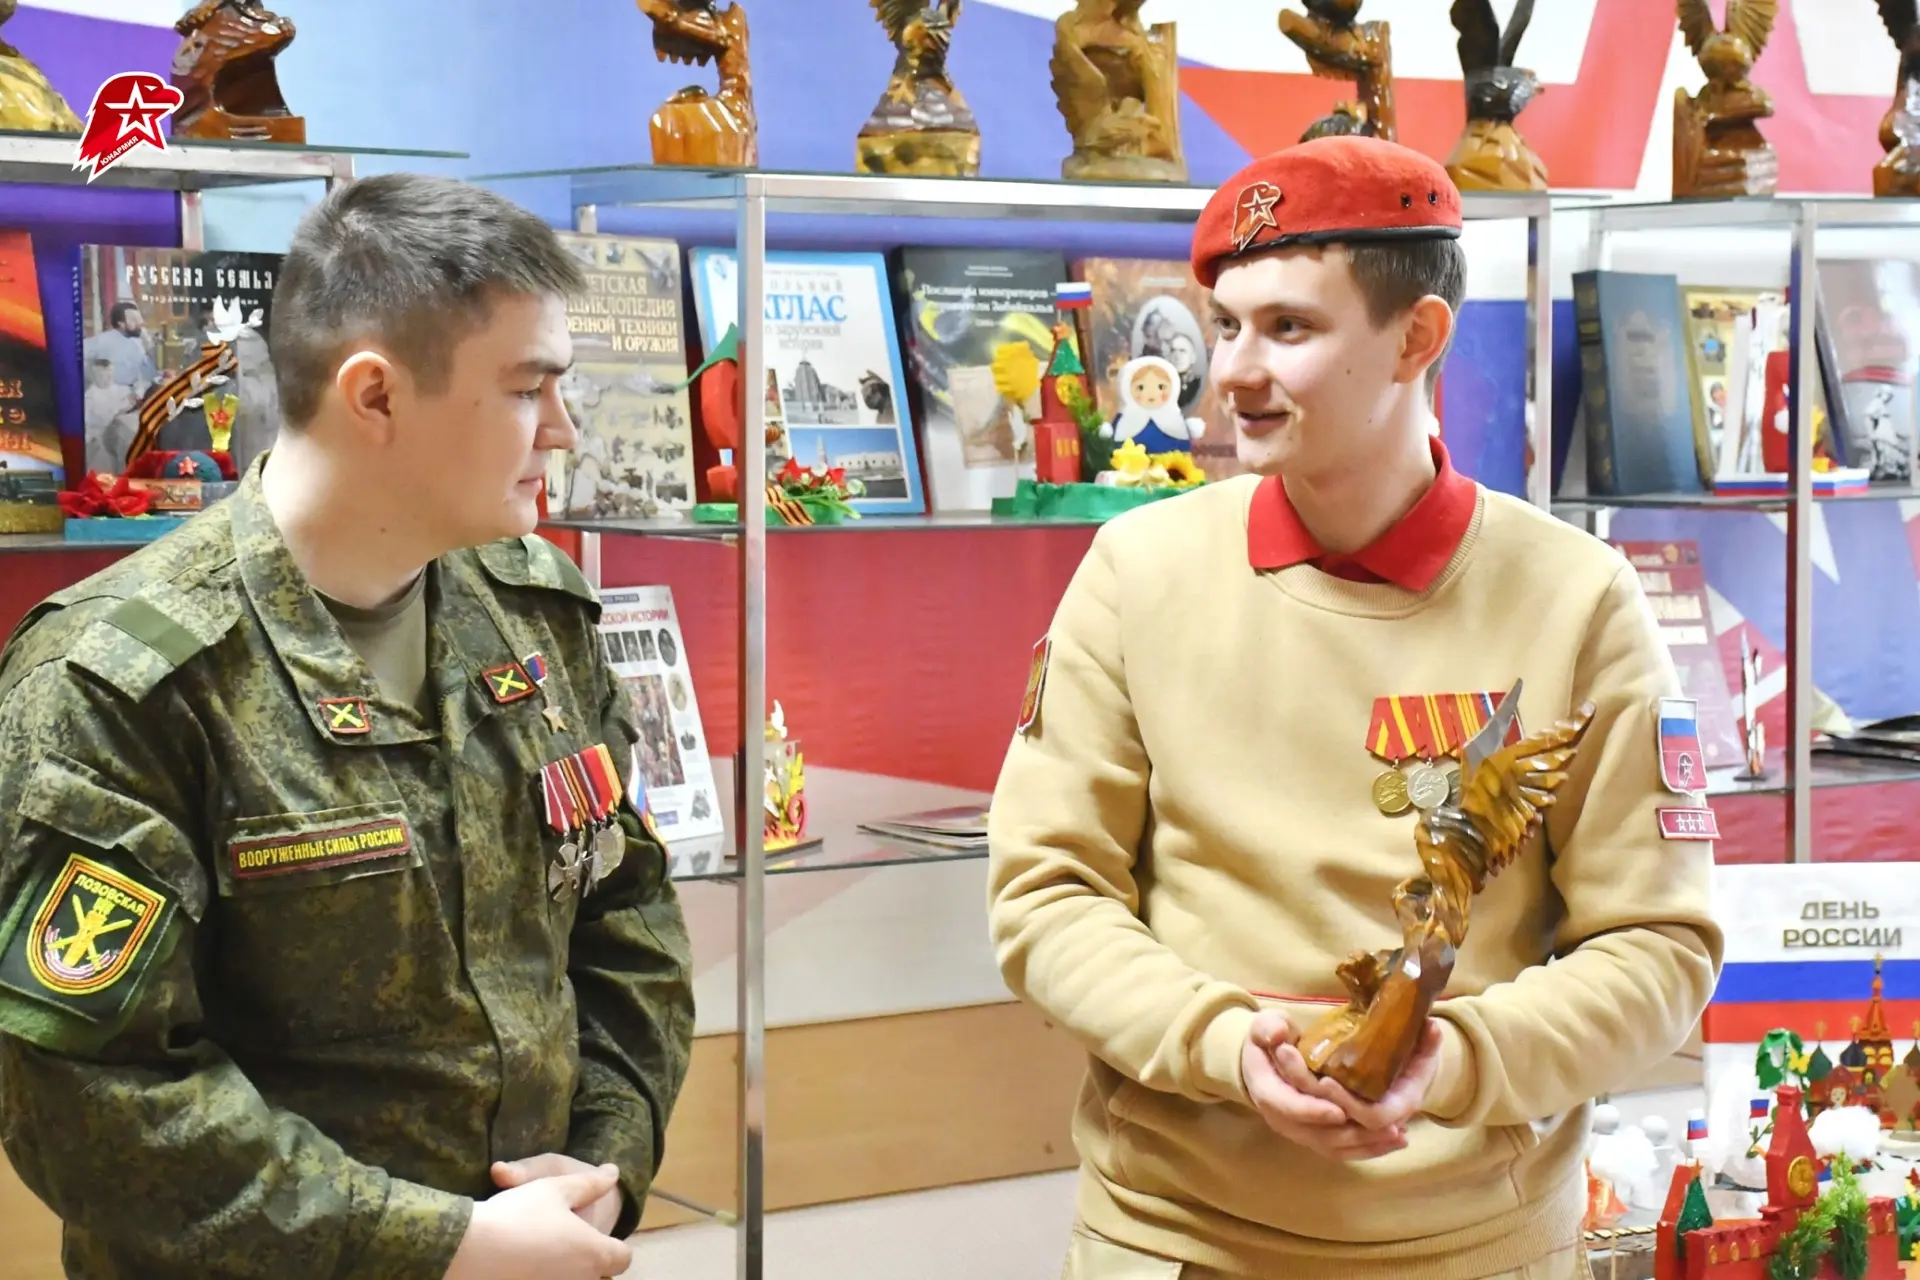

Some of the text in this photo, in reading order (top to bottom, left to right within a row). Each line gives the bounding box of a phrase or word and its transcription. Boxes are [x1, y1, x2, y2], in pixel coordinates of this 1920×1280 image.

[563, 294, 676, 318] НЦИКЛОПЕДИЯ
[764, 293, 848, 322] ТЛАС
[612, 334, 679, 354] И ОРУЖИЯ
[238, 841, 325, 869] ВООРУЖЕННЫЕ
[360, 827, 404, 850] РОССИИ
[75, 873, 147, 917] ЛОЗОВСКАЯ
[1800, 900, 1880, 921] ДЕНЬ
[1783, 927, 1902, 948] РОССИИ
